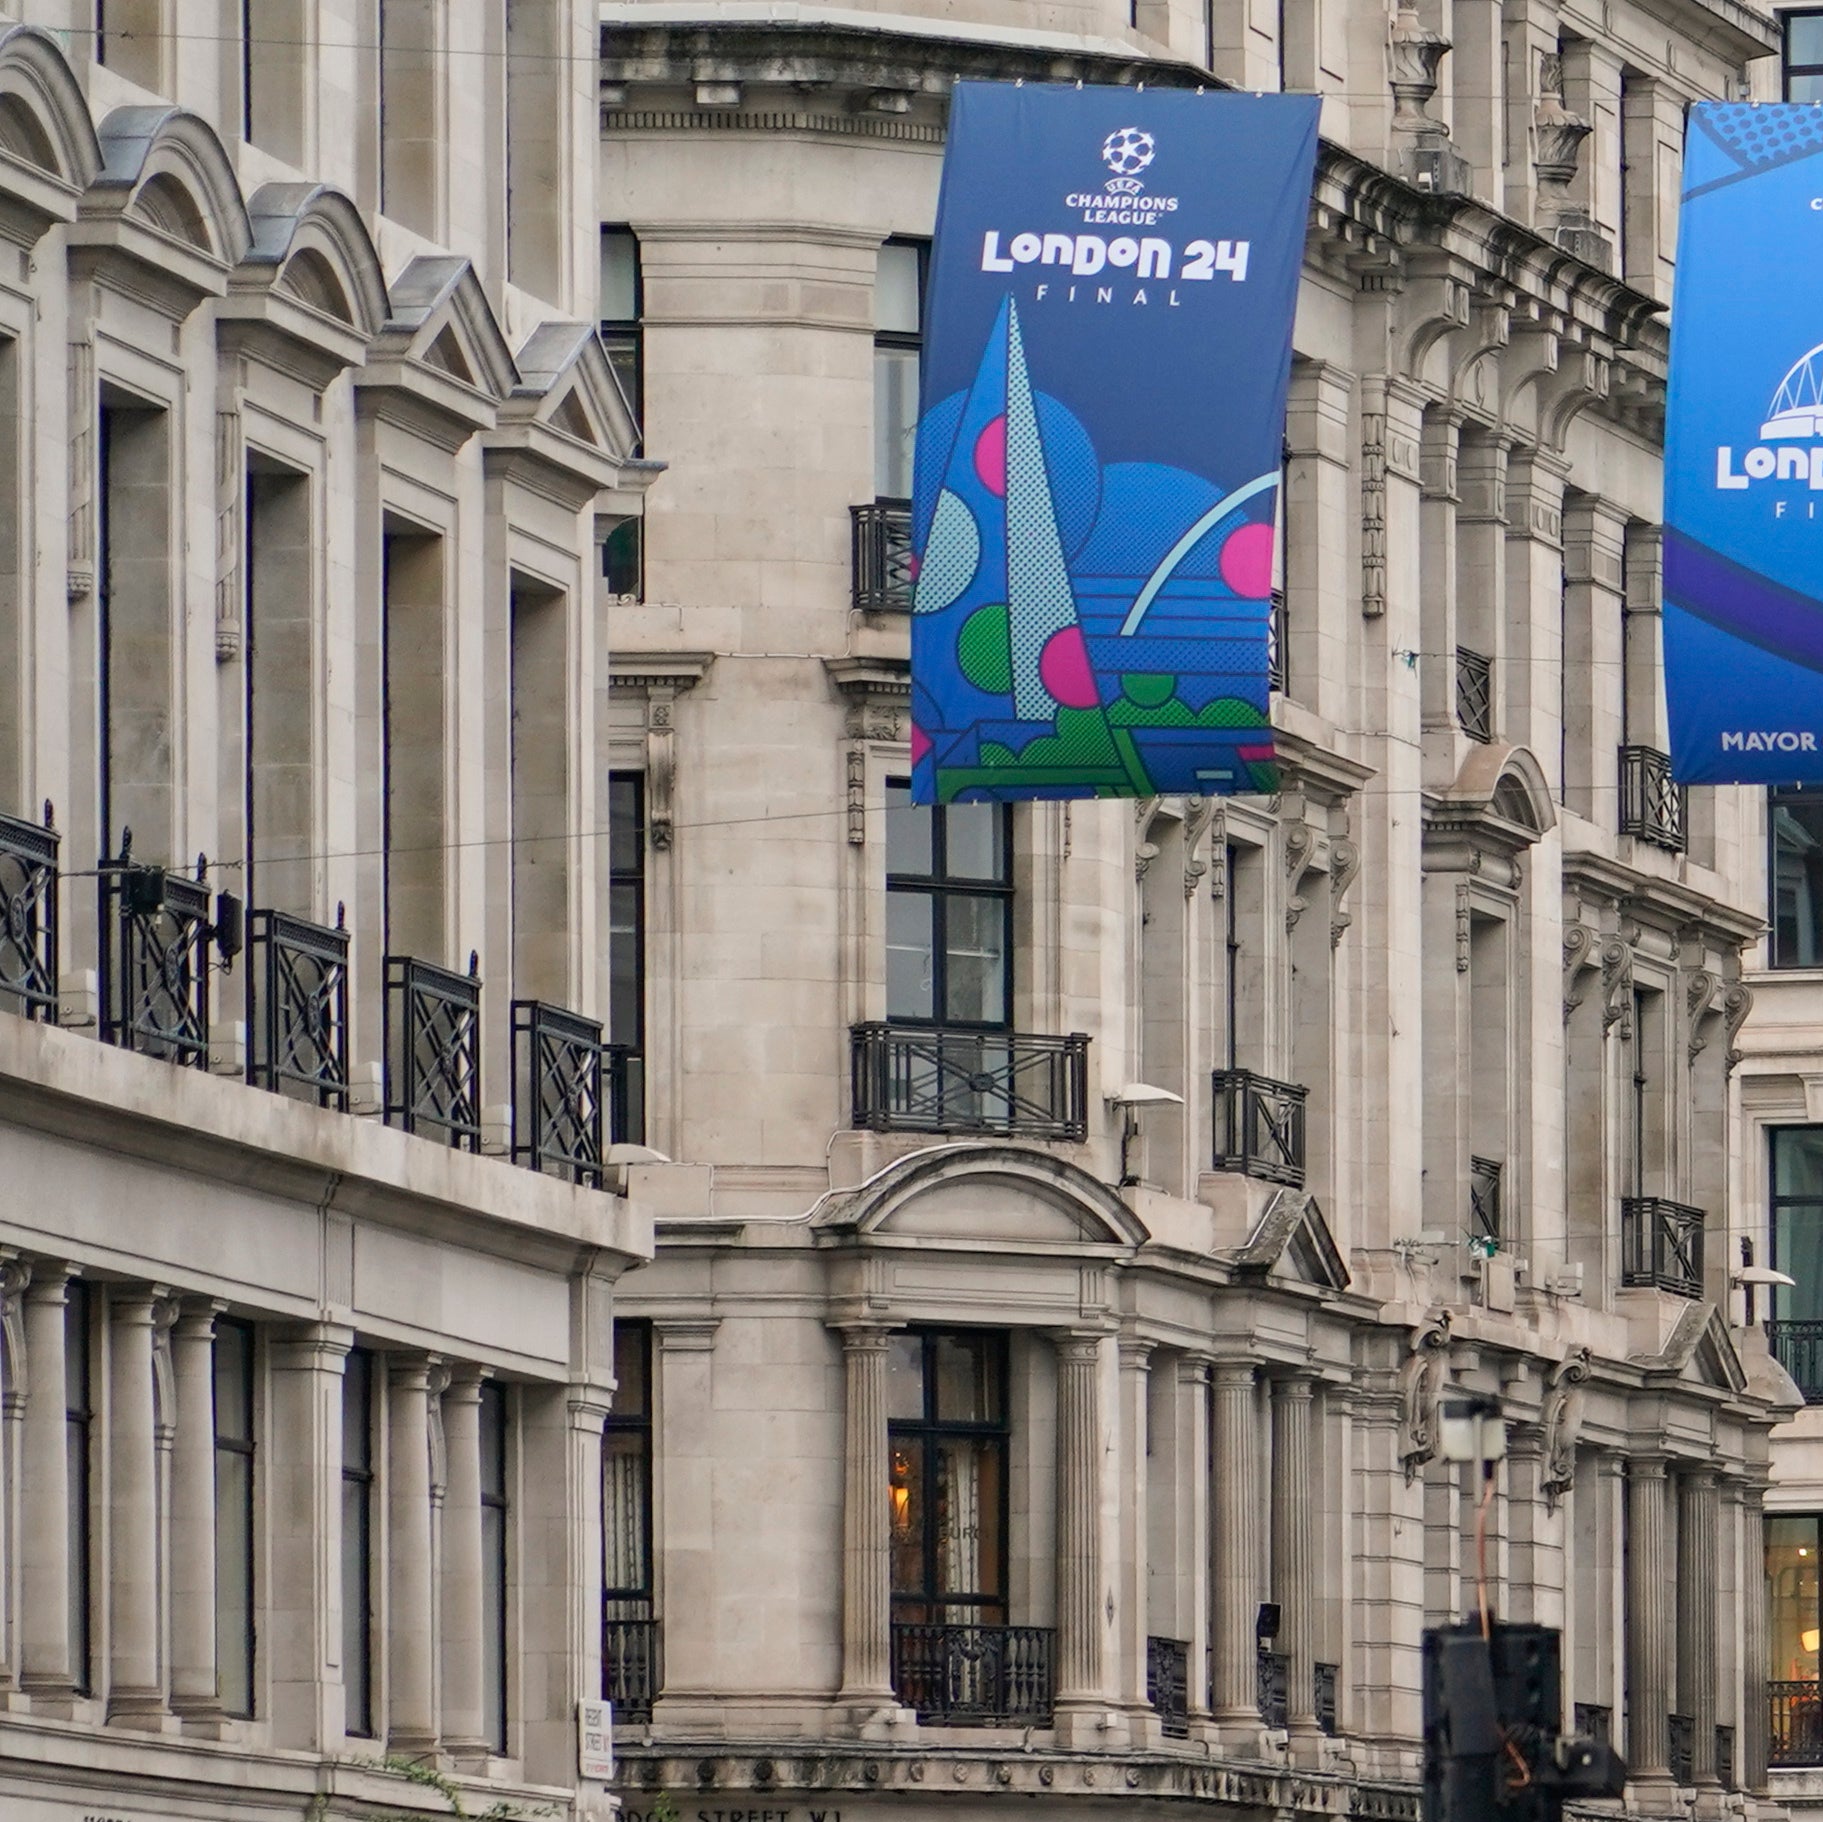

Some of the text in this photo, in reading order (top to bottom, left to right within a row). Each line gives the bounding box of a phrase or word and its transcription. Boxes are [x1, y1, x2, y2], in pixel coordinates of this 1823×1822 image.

[1065, 193, 1179, 212] CHAMPIONS
[1083, 210, 1158, 226] LEAGUE
[1180, 239, 1250, 282] 24
[1036, 284, 1181, 306] FINAL
[1720, 732, 1817, 752] MAYOR
